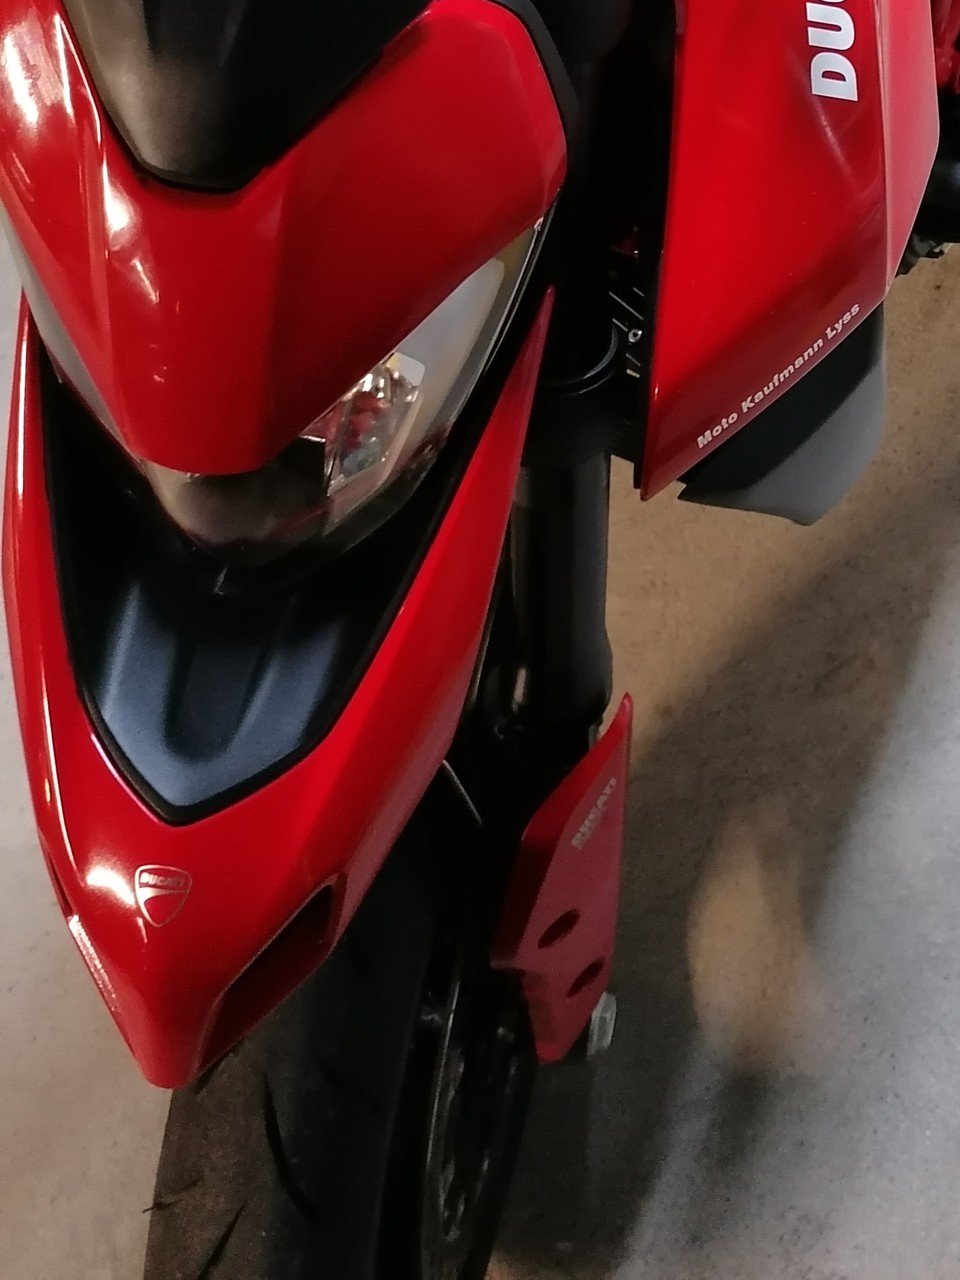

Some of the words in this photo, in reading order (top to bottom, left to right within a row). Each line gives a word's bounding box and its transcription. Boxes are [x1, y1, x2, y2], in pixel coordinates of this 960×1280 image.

[696, 412, 738, 449] Moto
[741, 338, 824, 413] Kaufmann
[825, 303, 860, 340] Lyss
